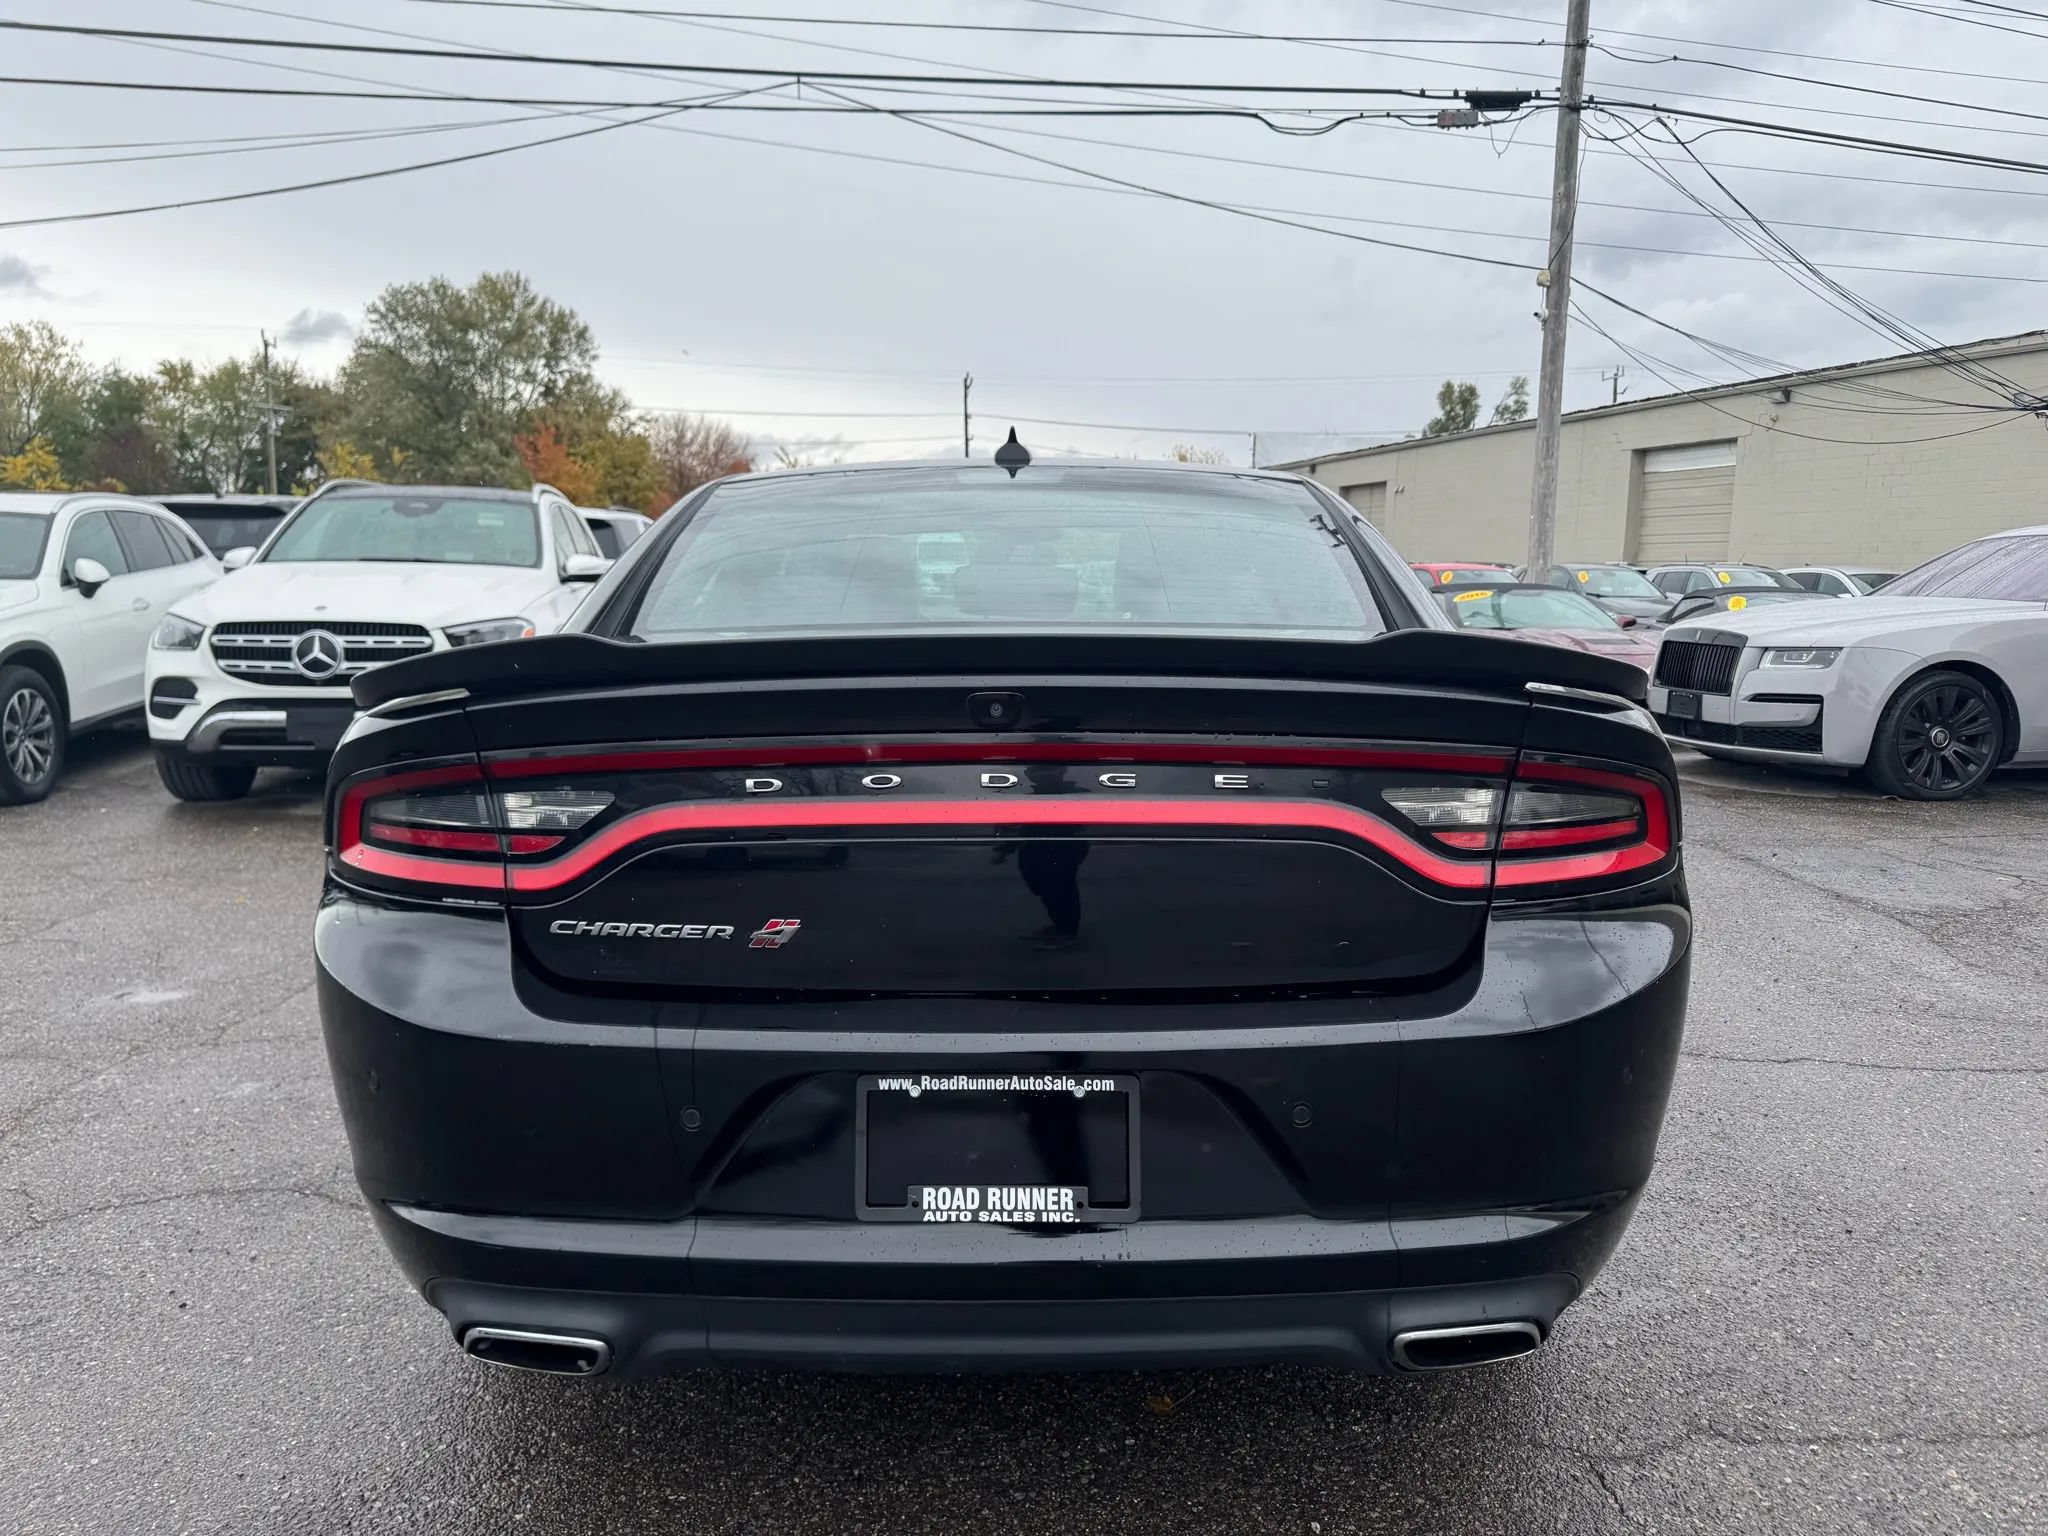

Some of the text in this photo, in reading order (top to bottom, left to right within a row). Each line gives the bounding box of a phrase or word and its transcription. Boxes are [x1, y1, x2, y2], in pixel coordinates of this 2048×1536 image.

[745, 772, 1249, 793] DODGE
[549, 919, 735, 940] CHARGER
[878, 1075, 1115, 1092] wwwRoadRunnerAutoSalecom
[922, 1187, 1074, 1211] ROAD RUNNER
[922, 1210, 1081, 1223] AUTO SALES INC.
